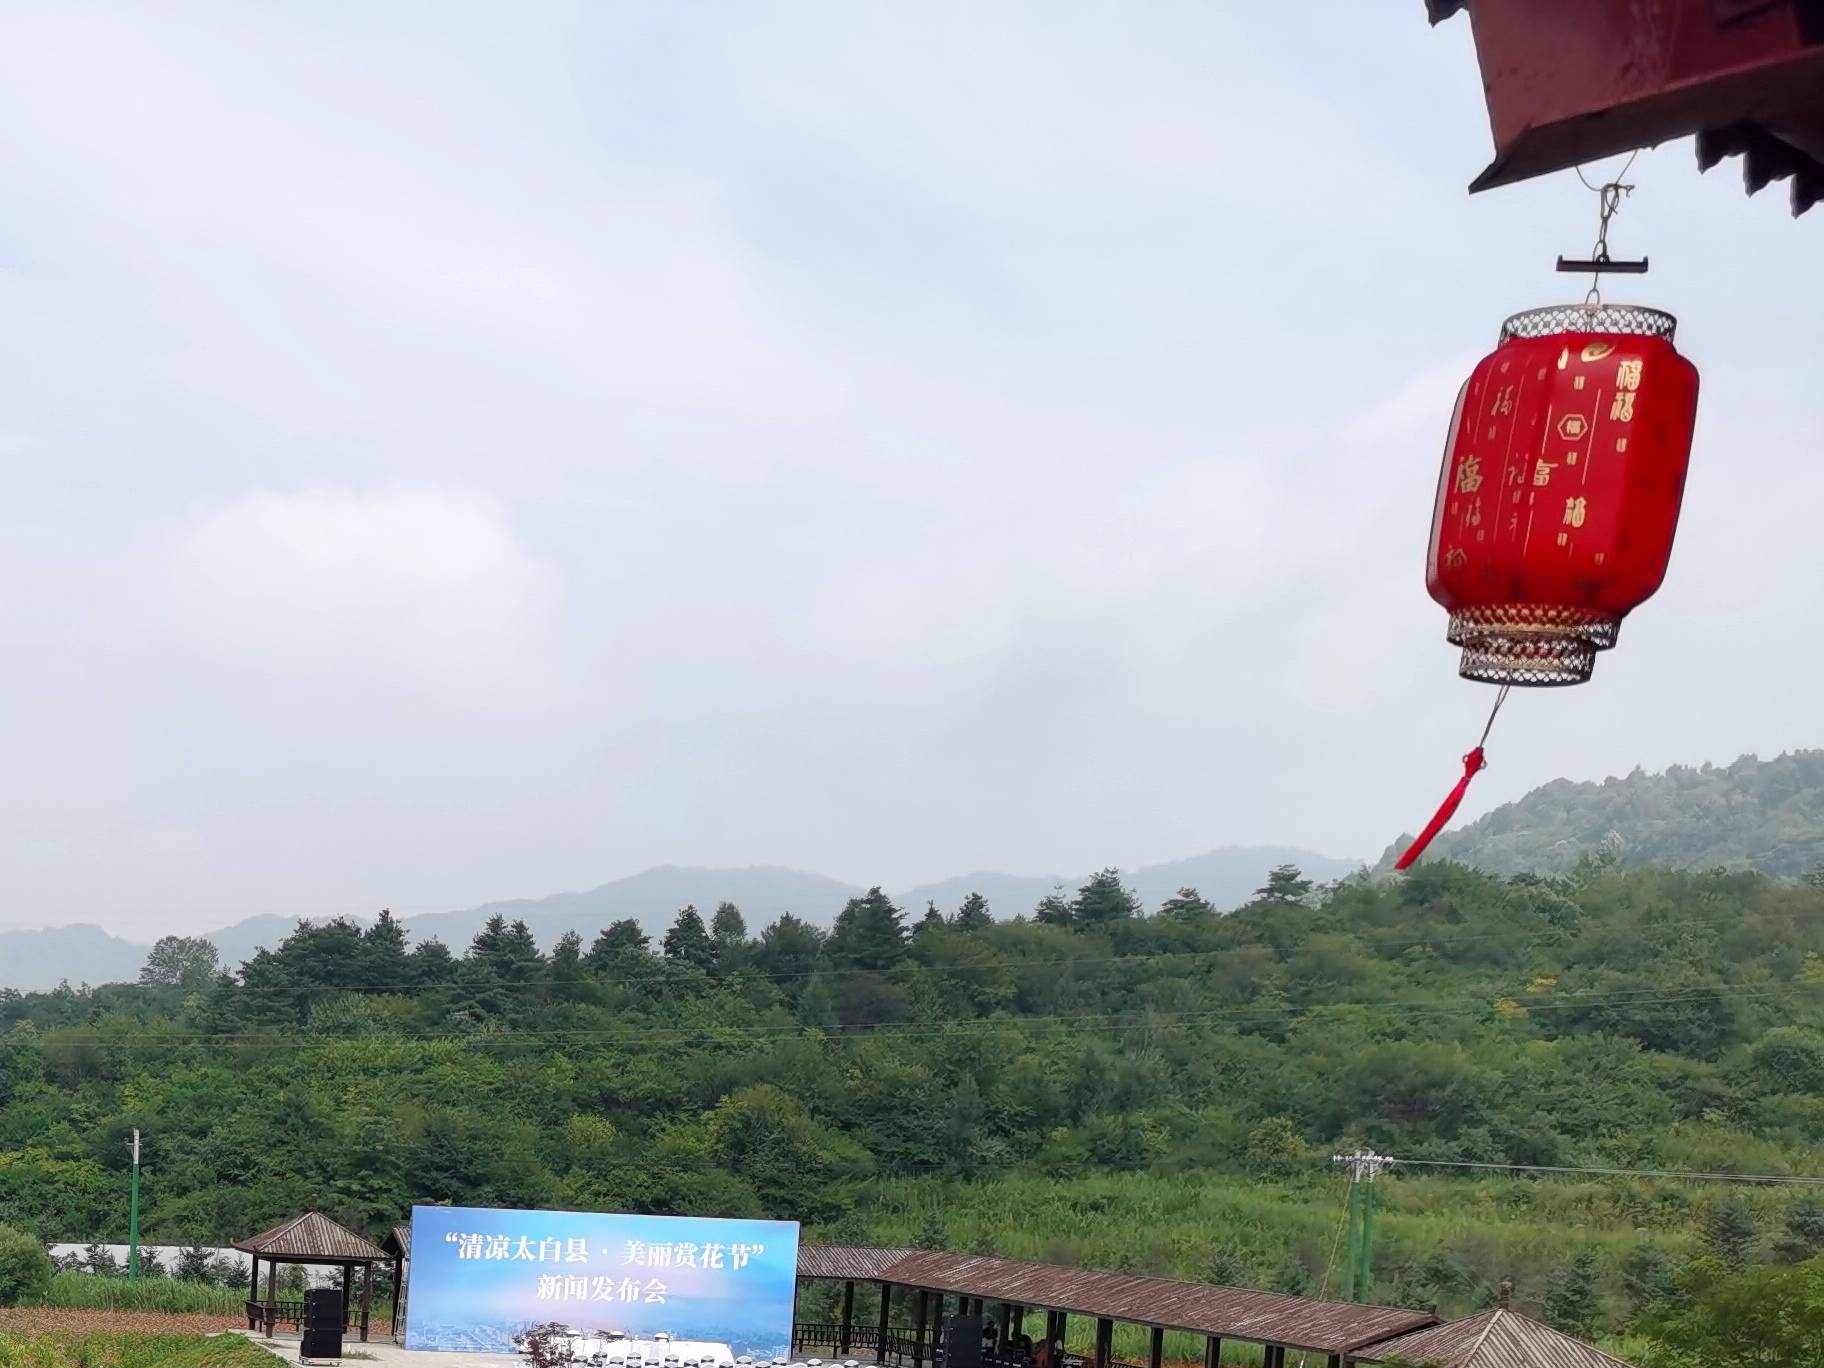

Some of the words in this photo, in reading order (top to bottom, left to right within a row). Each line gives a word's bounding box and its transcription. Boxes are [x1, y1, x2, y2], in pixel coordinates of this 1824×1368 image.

[536, 1273, 669, 1305] 新闻发布会
